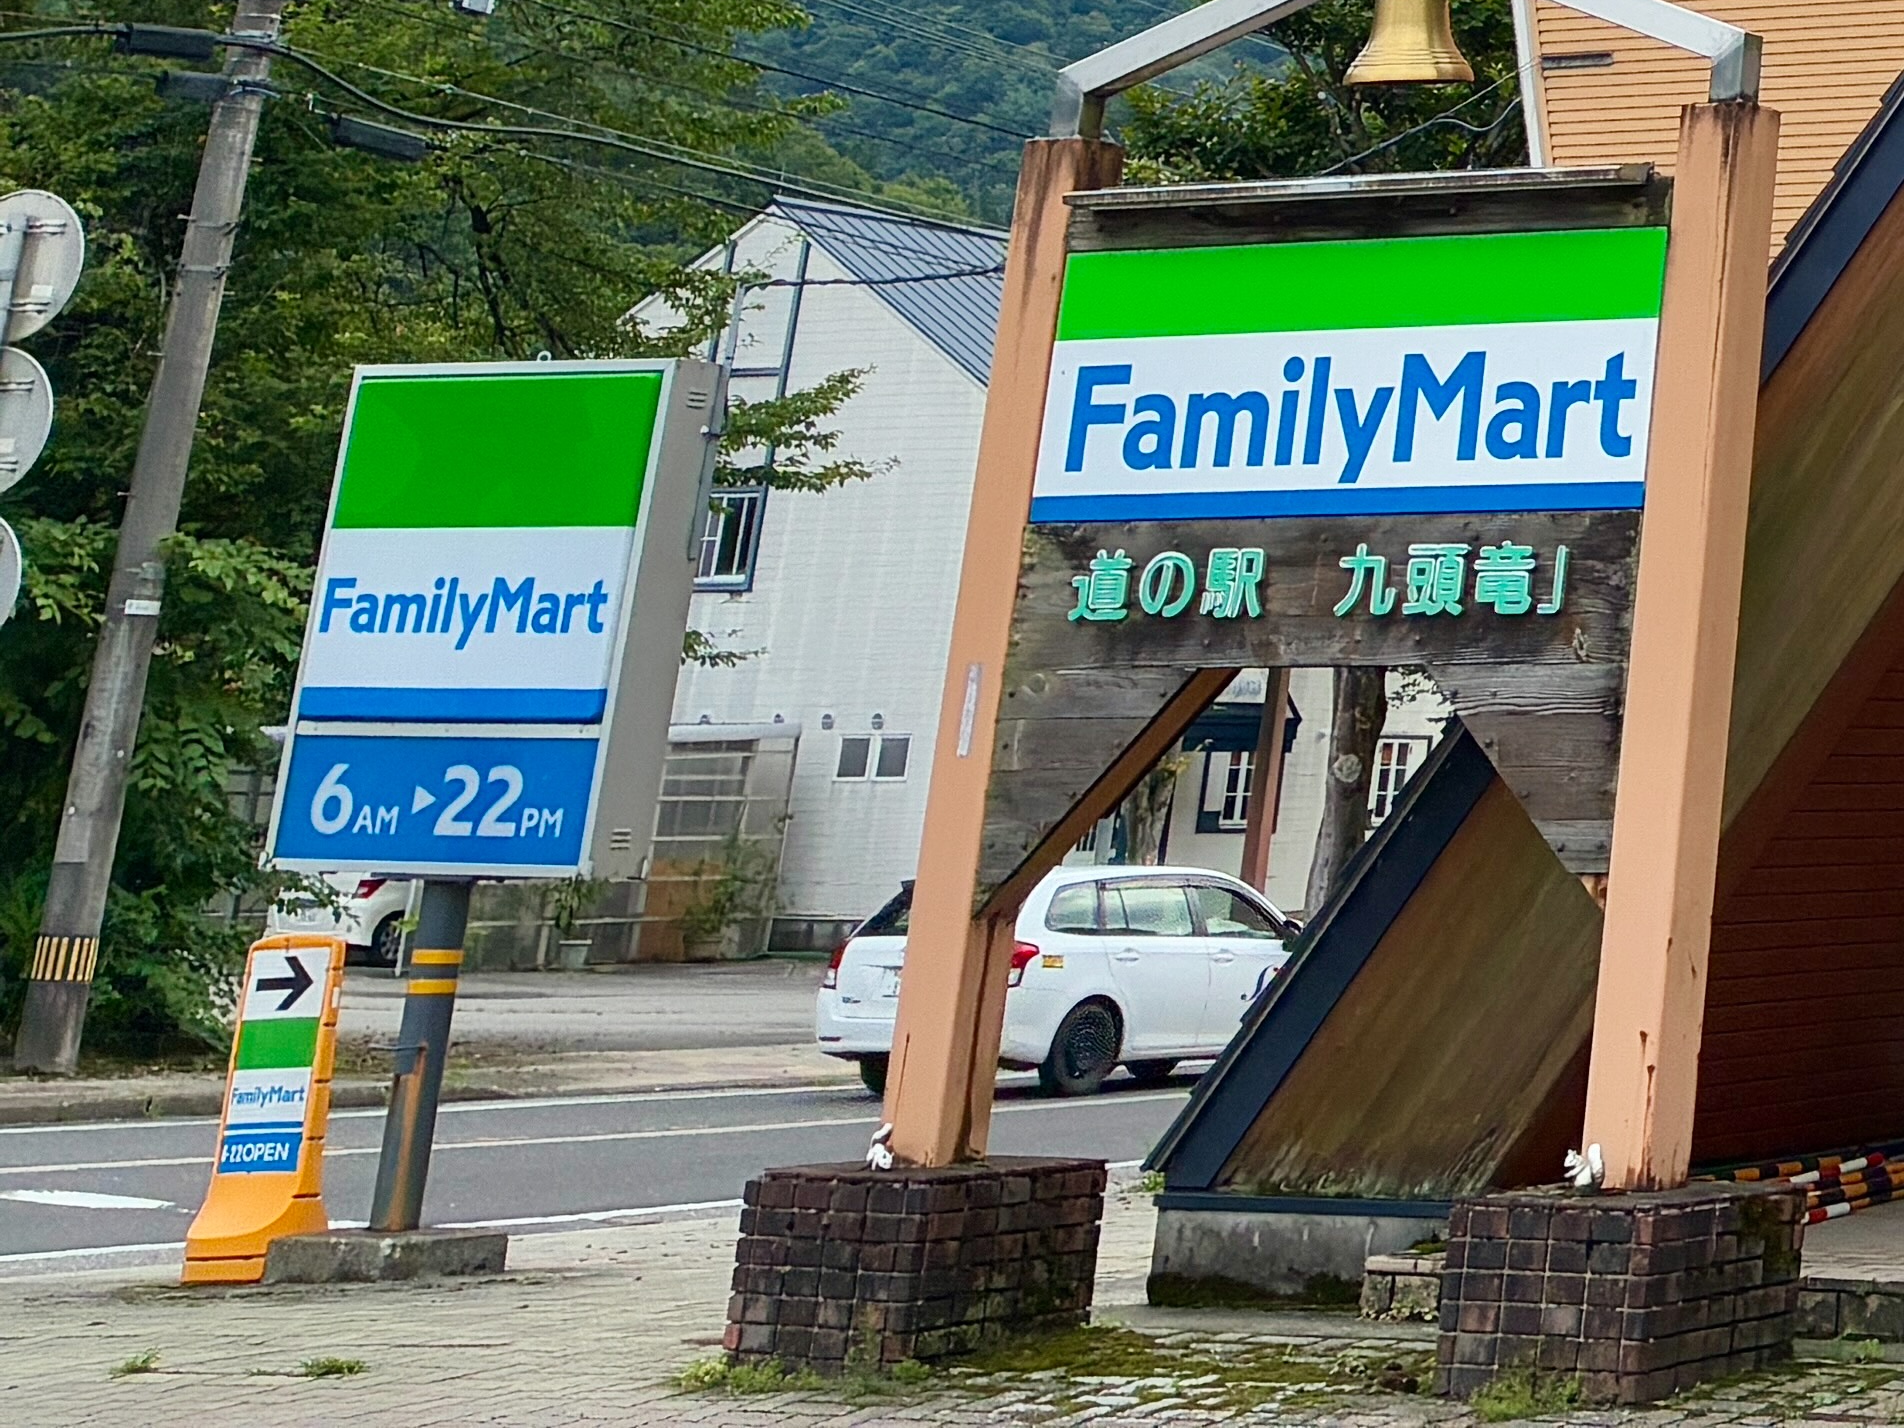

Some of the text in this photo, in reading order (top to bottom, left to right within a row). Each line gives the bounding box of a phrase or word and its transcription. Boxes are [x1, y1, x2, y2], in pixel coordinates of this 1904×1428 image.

[1064, 350, 1638, 485] FamilyMart
[318, 577, 609, 651] FamilyMart
[1067, 546, 1266, 622] 道の駅
